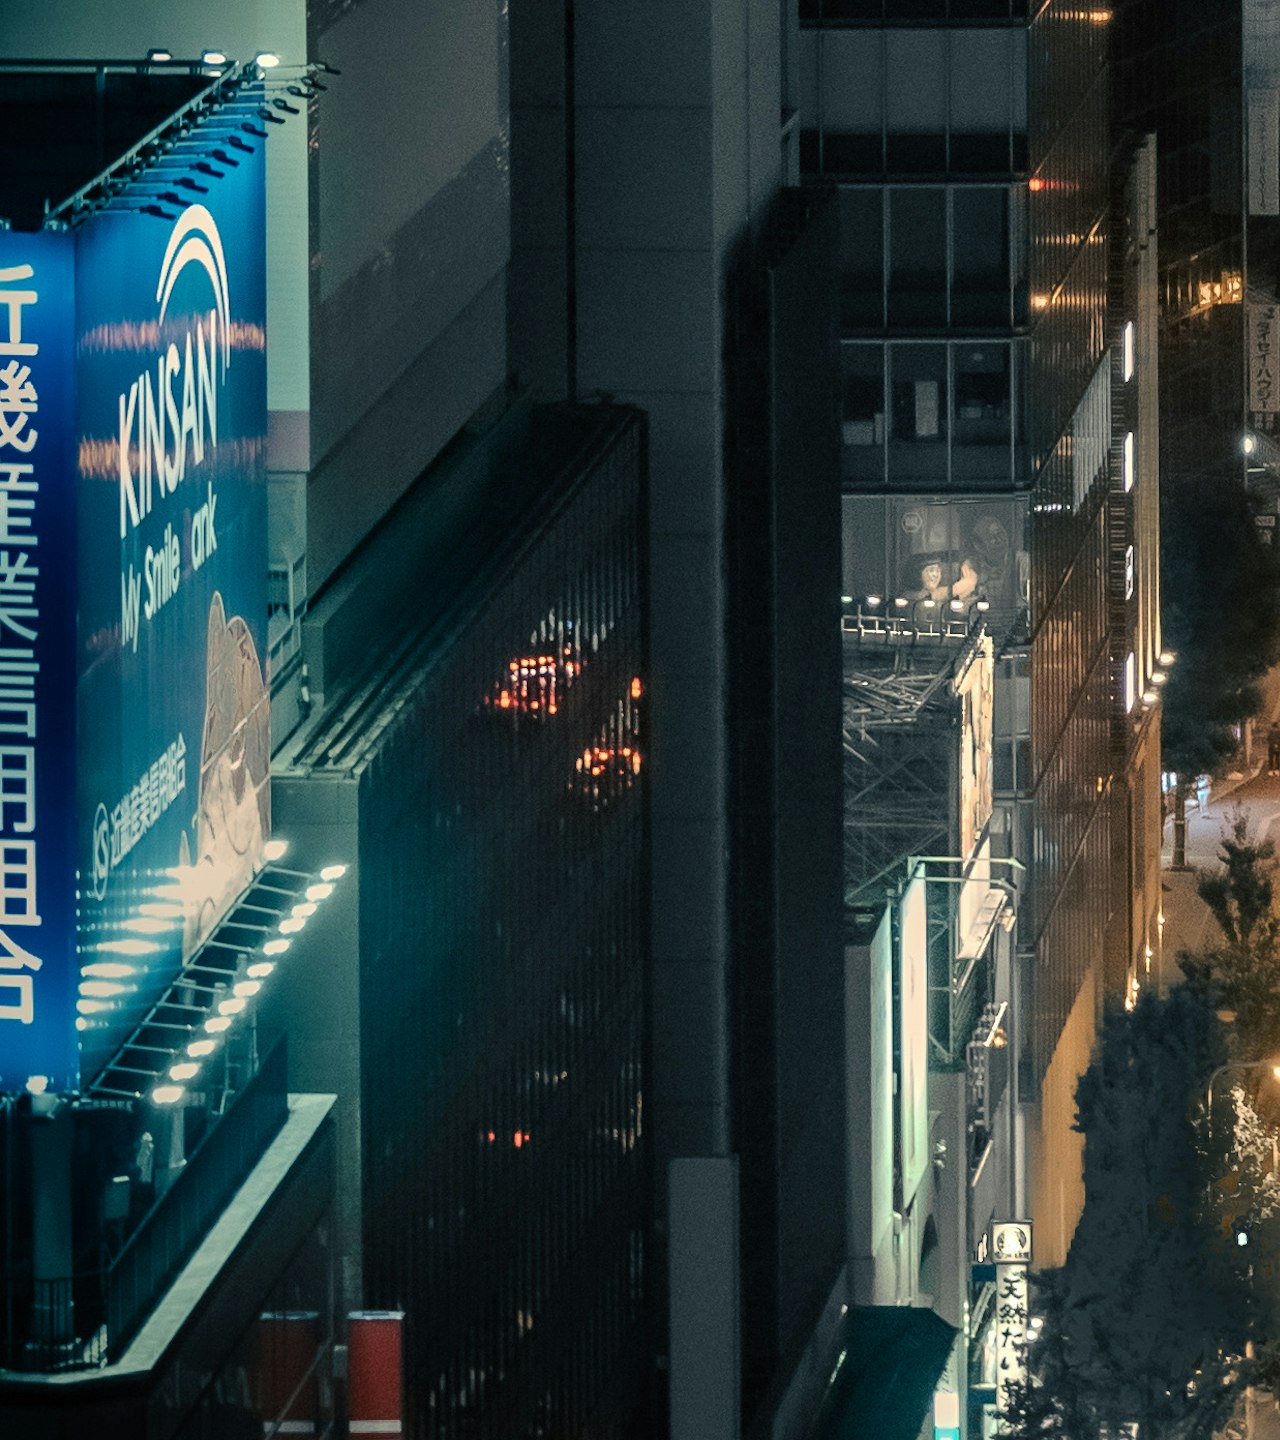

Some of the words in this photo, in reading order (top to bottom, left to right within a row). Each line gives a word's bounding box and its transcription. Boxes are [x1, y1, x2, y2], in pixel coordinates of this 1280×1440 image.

[119, 308, 217, 540] KINSAN
[121, 570, 141, 654] My
[144, 522, 181, 622] Smile
